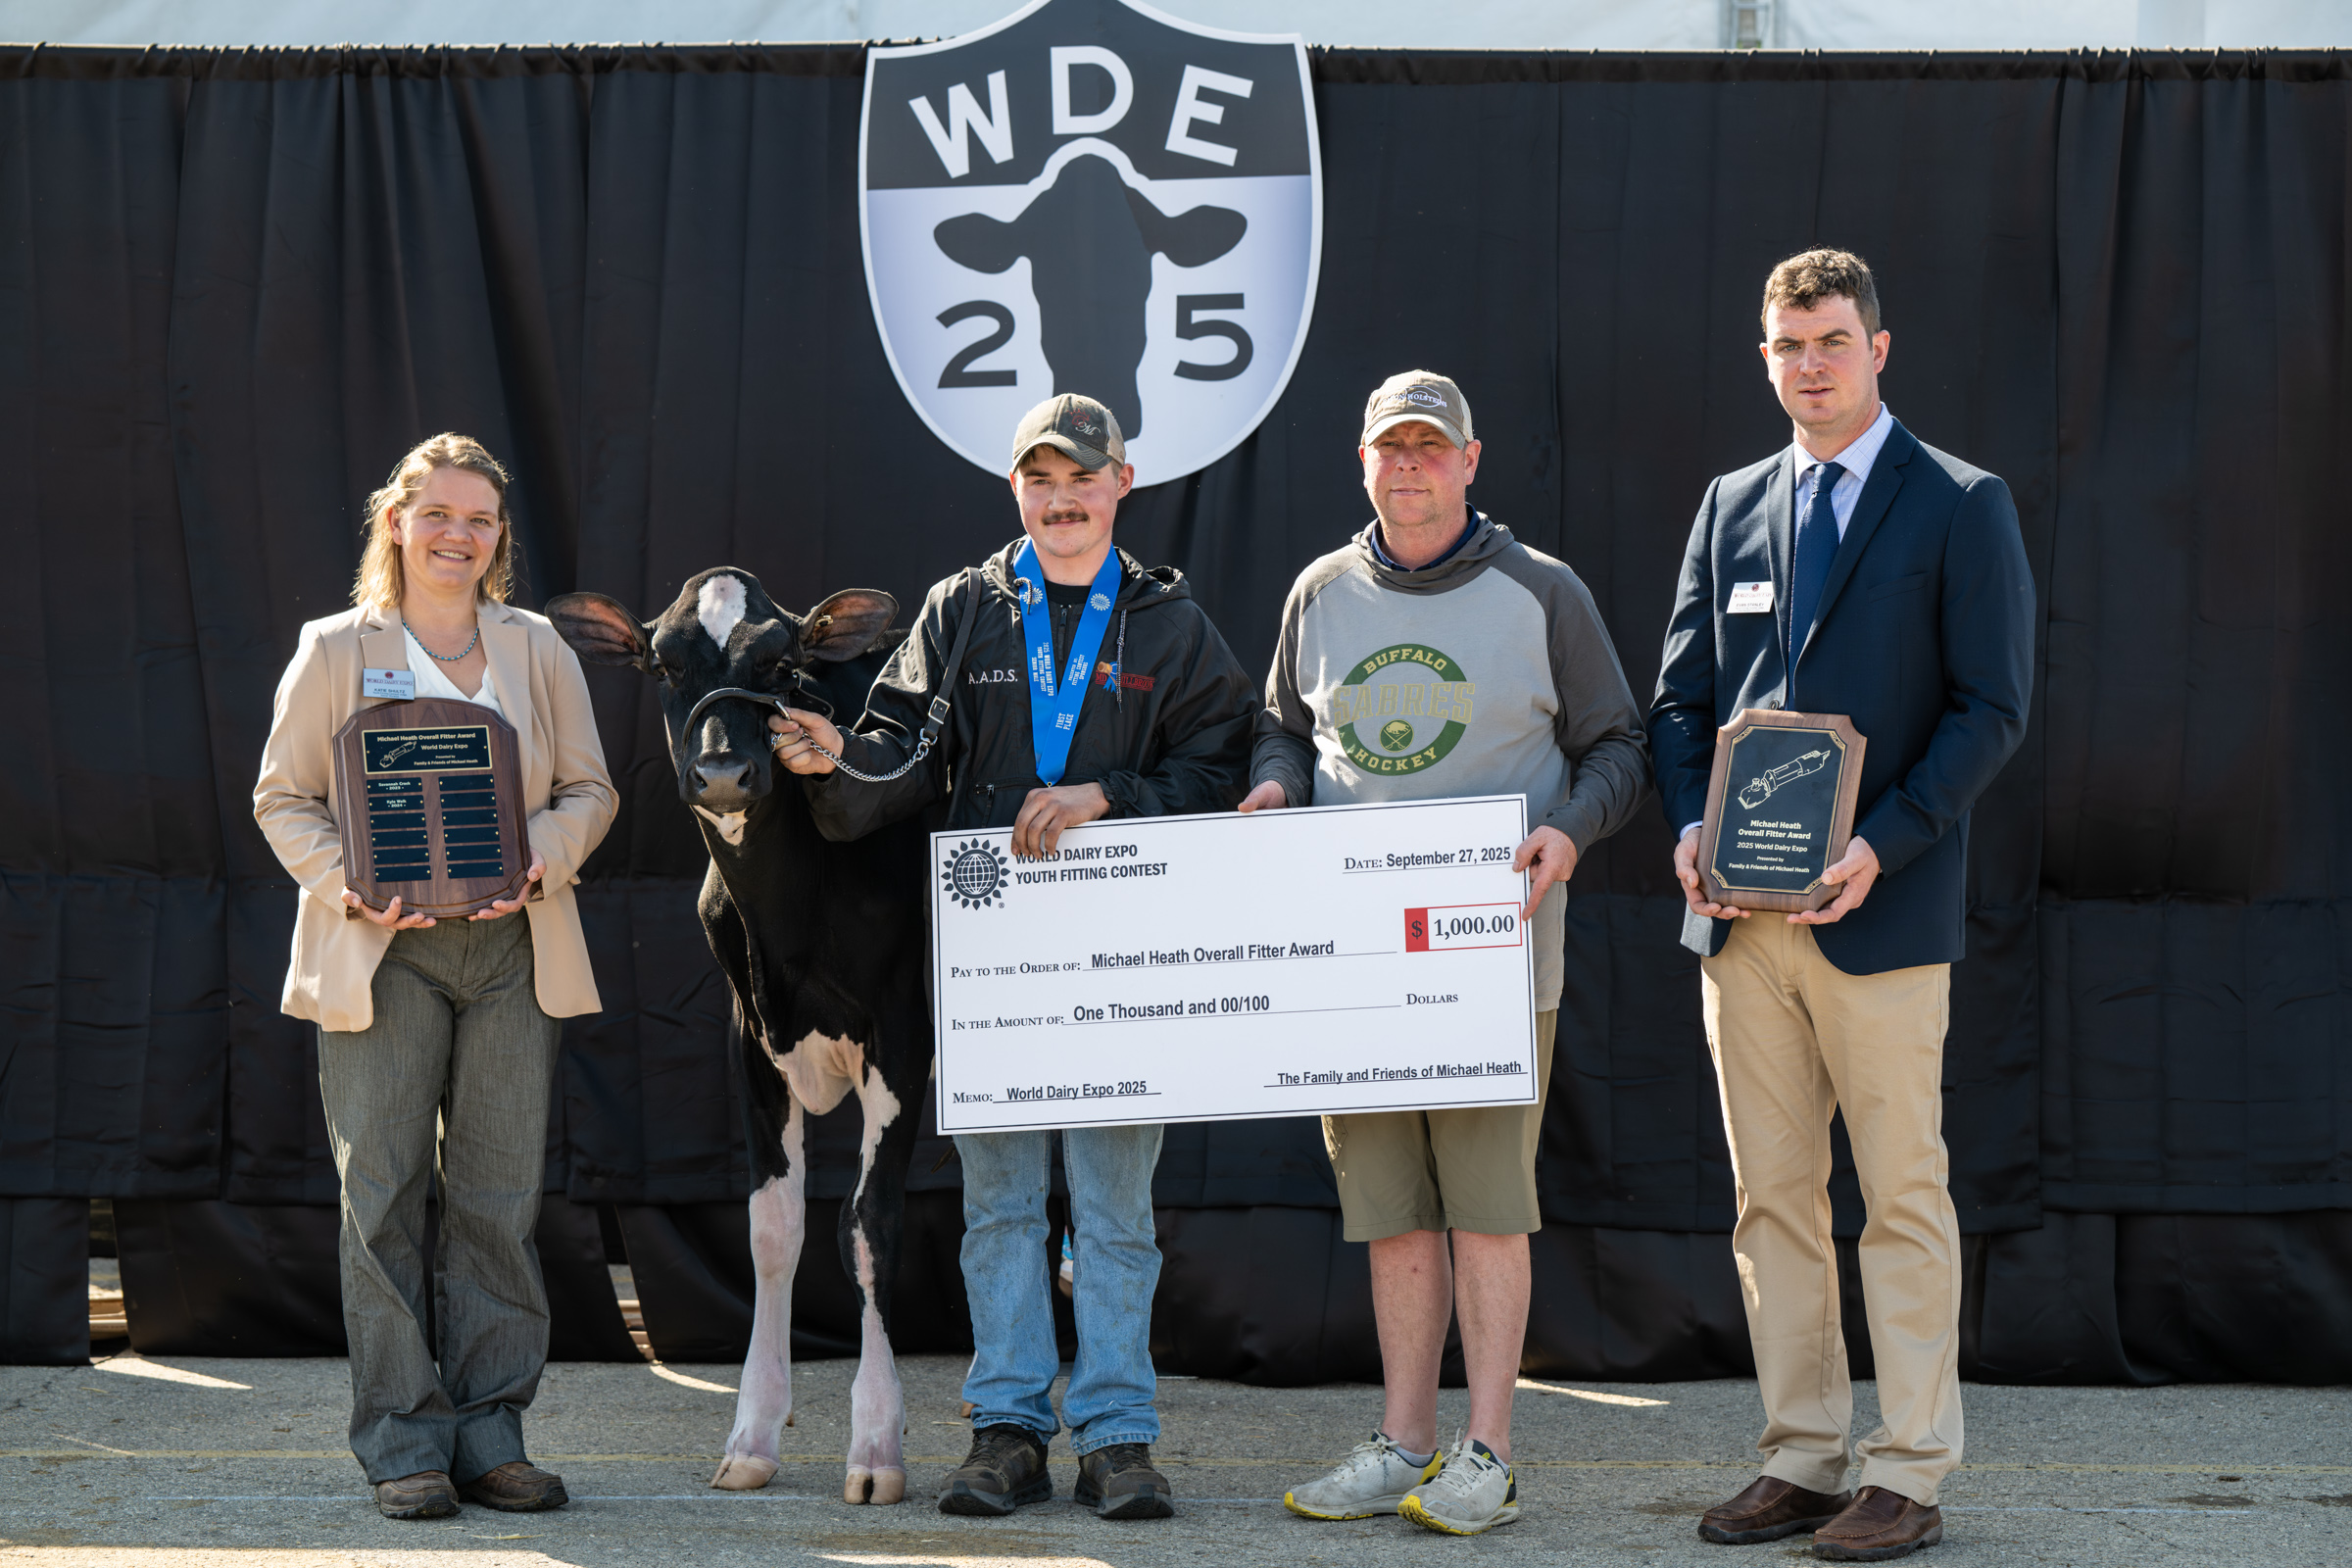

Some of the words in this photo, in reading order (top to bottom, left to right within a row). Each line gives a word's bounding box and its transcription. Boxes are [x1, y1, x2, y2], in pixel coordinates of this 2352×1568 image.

[908, 45, 1253, 178] WDE
[935, 299, 1017, 389] 2
[1173, 292, 1253, 382] 5
[1407, 392, 1447, 408] HOLSTEINS
[1363, 648, 1447, 674] BUFFALO
[968, 669, 1018, 685] A.A.D.S.
[1096, 672, 1107, 682] MD
[1333, 682, 1475, 728] SABRES
[1055, 712, 1066, 729] FIRST
[1063, 713, 1074, 730] PLACE
[1354, 747, 1438, 771] HOCKEY
[1750, 820, 1778, 828] Michael
[1064, 847, 1102, 861] DAIRY
[1105, 844, 1138, 858] EXPO
[1386, 851, 1455, 869] September
[1459, 849, 1477, 864] 27,
[1481, 847, 1511, 861] 2025
[1774, 844, 1791, 852] Dairy
[1015, 870, 1057, 884] YOUTH
[1060, 867, 1107, 882] FITTING
[1111, 862, 1168, 879] CONTEST
[1433, 915, 1515, 940] 1,000.00
[1091, 951, 1145, 968] Michael
[1149, 948, 1189, 965] Heath
[1194, 946, 1244, 962] Overall
[1248, 942, 1286, 959] Fitter
[1289, 940, 1334, 956] Award
[1073, 1005, 1104, 1021] One
[1108, 999, 1184, 1020] Thousand
[1188, 998, 1216, 1014] and
[1221, 995, 1270, 1013] 00/100
[1278, 1071, 1300, 1085] The
[1303, 1070, 1343, 1085] Family
[1346, 1069, 1369, 1082] and
[1372, 1066, 1418, 1080] Friends
[1421, 1064, 1433, 1078] of
[1437, 1062, 1483, 1077] Michael
[1486, 1060, 1521, 1074] Heath
[1006, 1086, 1043, 1101] World
[1047, 1085, 1079, 1100] Dairy
[1082, 1083, 1114, 1098] Expo
[1118, 1080, 1147, 1095] 2025
